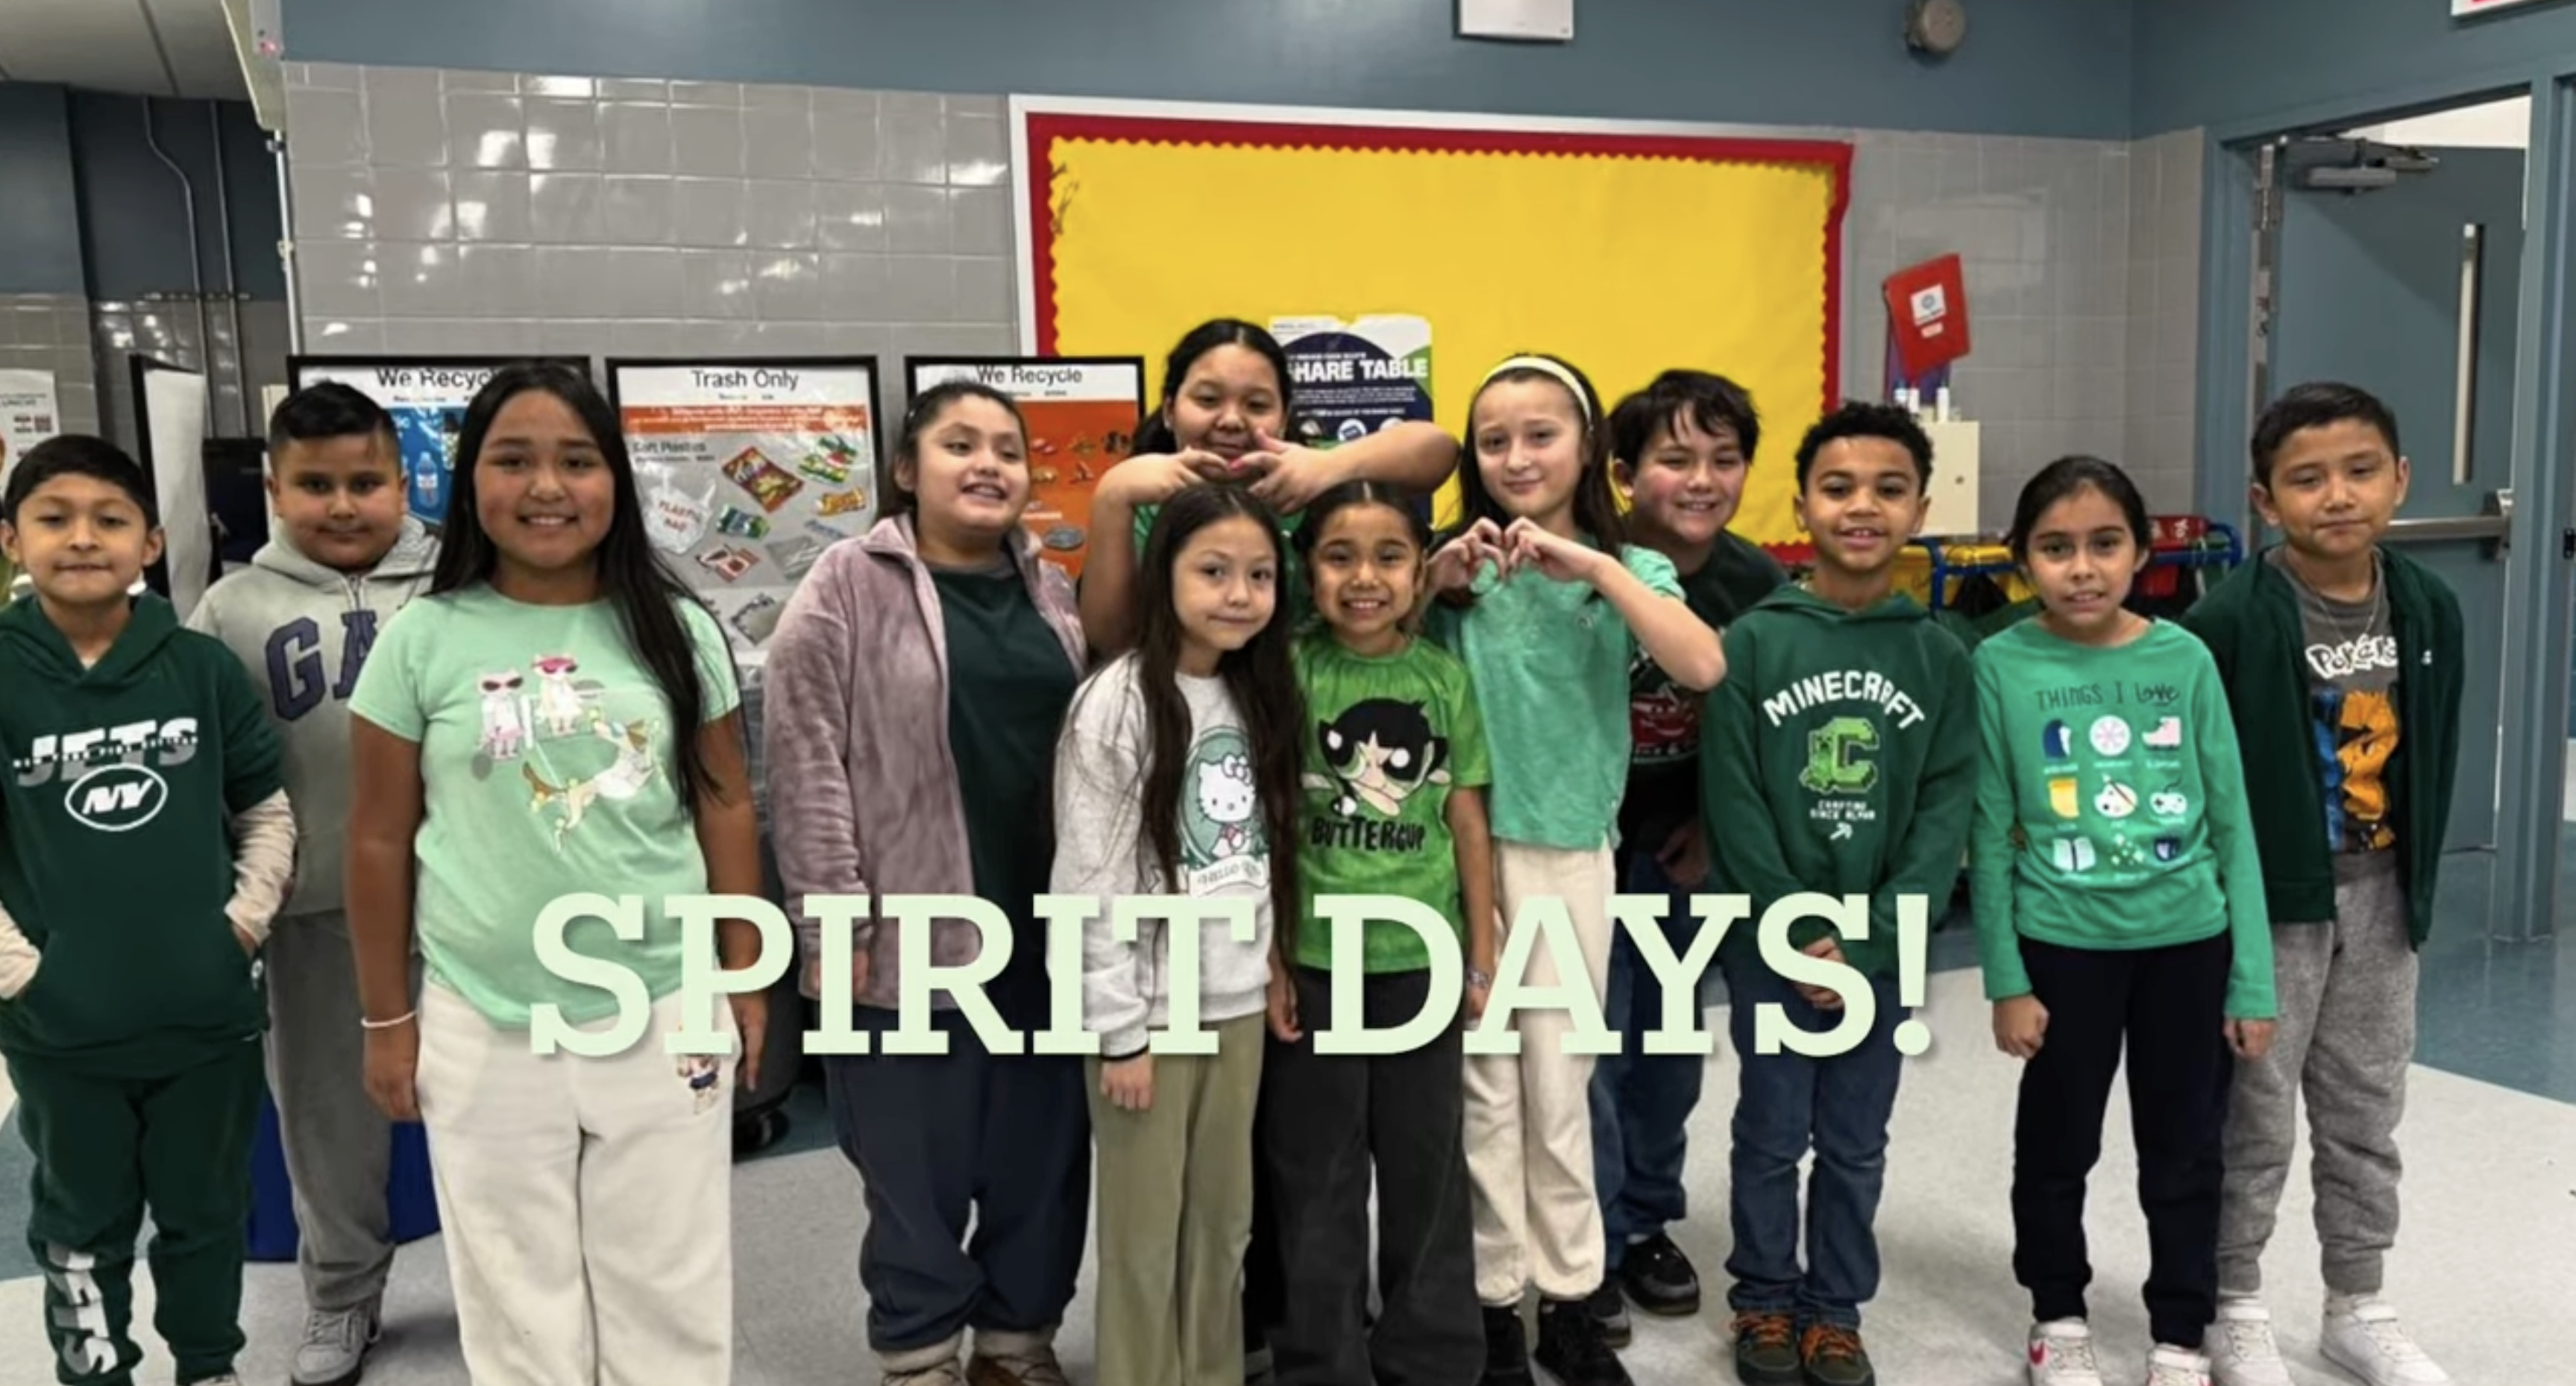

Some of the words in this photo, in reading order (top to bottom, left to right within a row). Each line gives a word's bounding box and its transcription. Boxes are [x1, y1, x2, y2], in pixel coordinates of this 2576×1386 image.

[377, 367, 411, 387] We
[420, 367, 493, 390] Recyc
[691, 369, 747, 387] Trash
[753, 368, 799, 392] Only
[977, 365, 1005, 384] We
[1011, 365, 1082, 386] Recycle
[1288, 361, 1354, 383] HARE
[1359, 358, 1428, 380] TABLE
[266, 610, 378, 722] GA
[2035, 683, 2103, 711] THINGS
[2115, 680, 2124, 706] I
[17, 717, 198, 788] JETS
[81, 778, 155, 815] NY
[1311, 815, 1425, 853] BUTTERCUP
